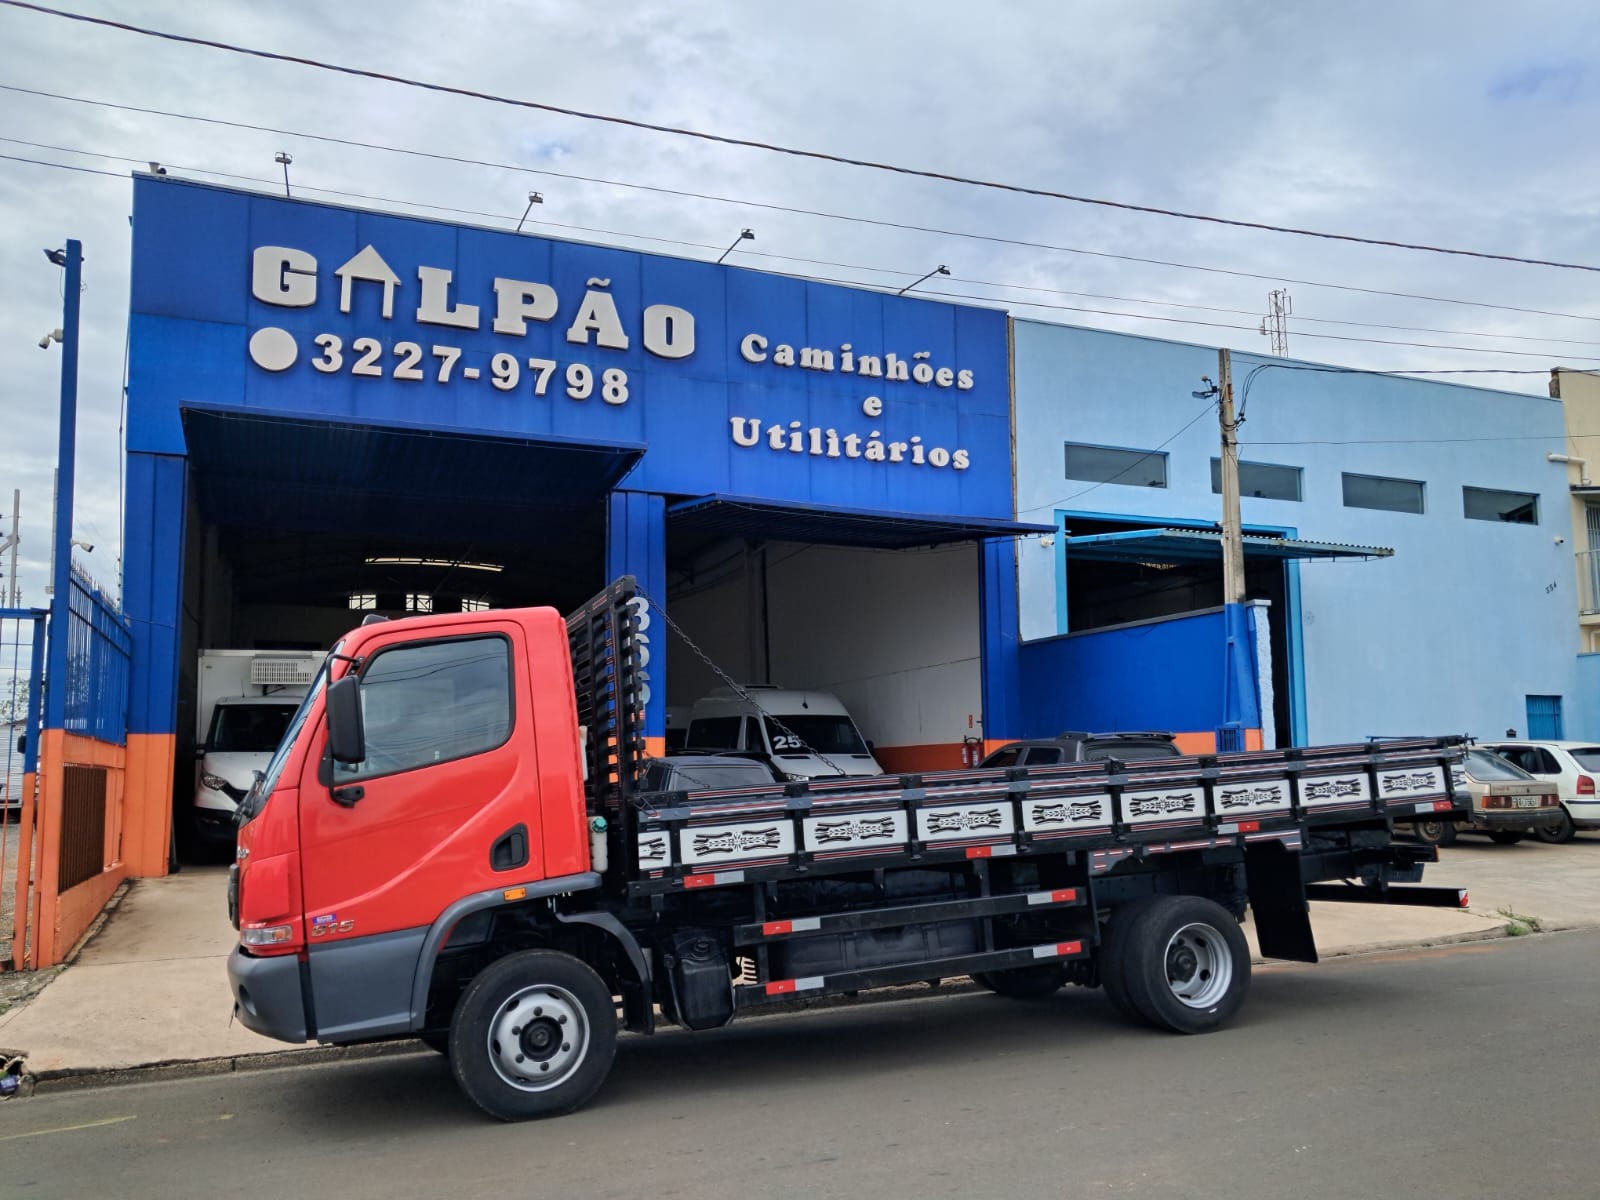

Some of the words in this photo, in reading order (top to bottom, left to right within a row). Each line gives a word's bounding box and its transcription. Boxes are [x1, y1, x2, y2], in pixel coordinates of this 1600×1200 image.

[311, 332, 629, 405] 3227-9798
[740, 333, 974, 390] Caminhões
[862, 396, 882, 417] e
[729, 416, 970, 470] Utilitários
[773, 735, 801, 750] 25
